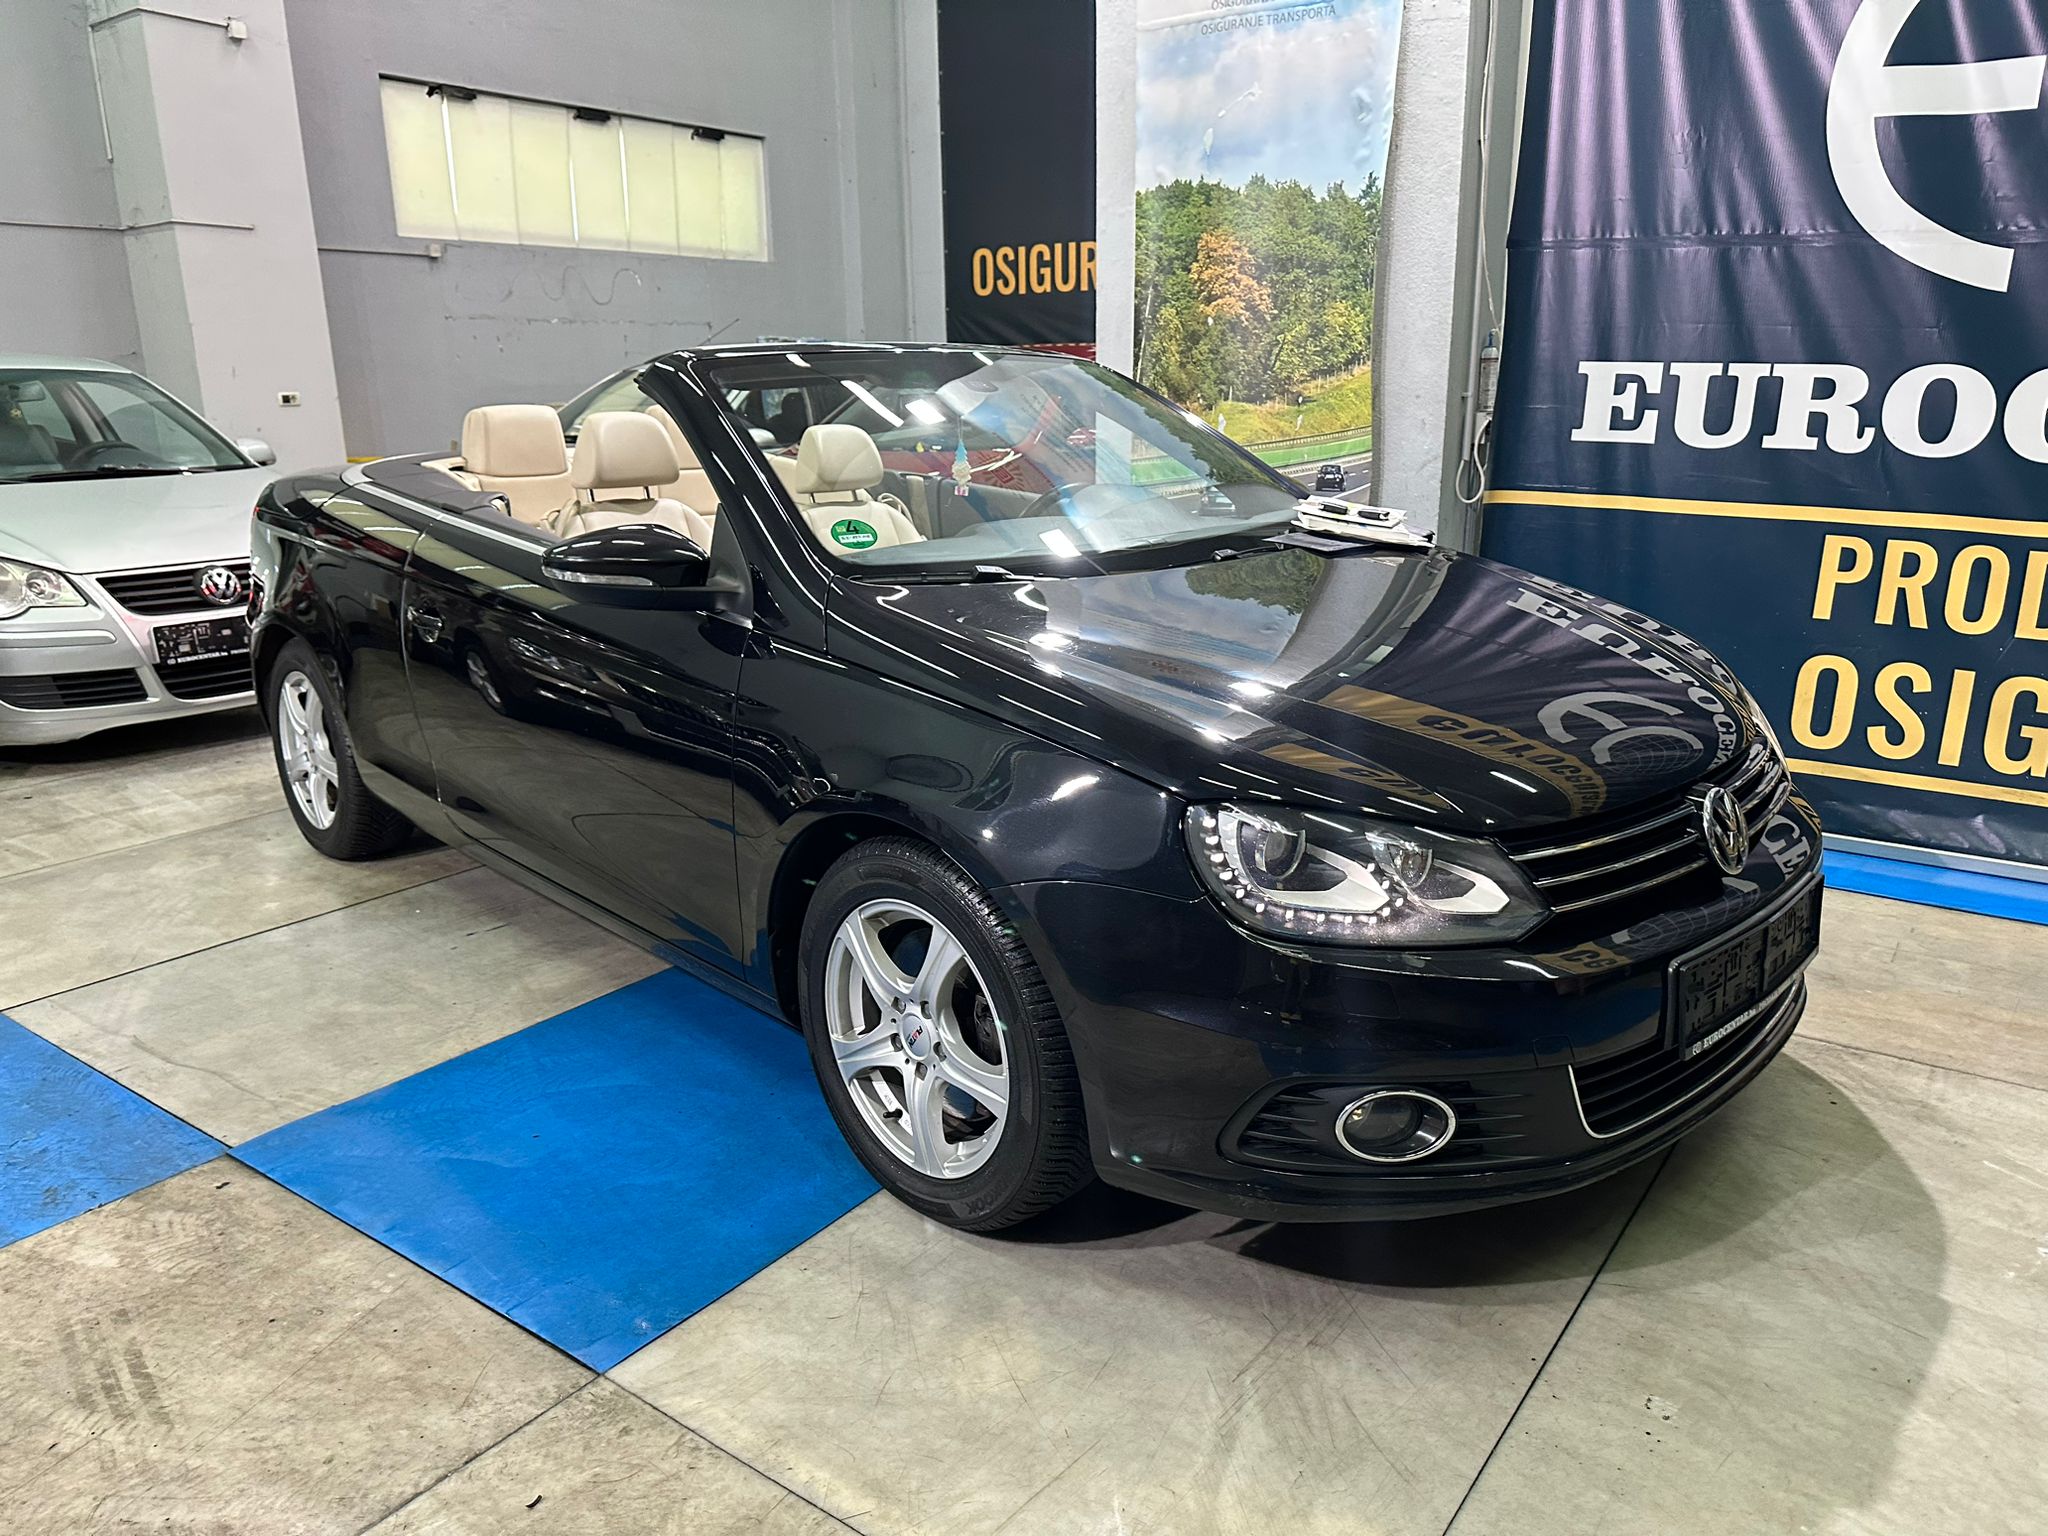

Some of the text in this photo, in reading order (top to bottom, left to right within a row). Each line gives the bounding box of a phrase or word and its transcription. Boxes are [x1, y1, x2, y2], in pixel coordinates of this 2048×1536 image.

[1201, 5, 1337, 36] OSIGURANJE TRANSPORTA
[972, 241, 1096, 297] OSIGUR
